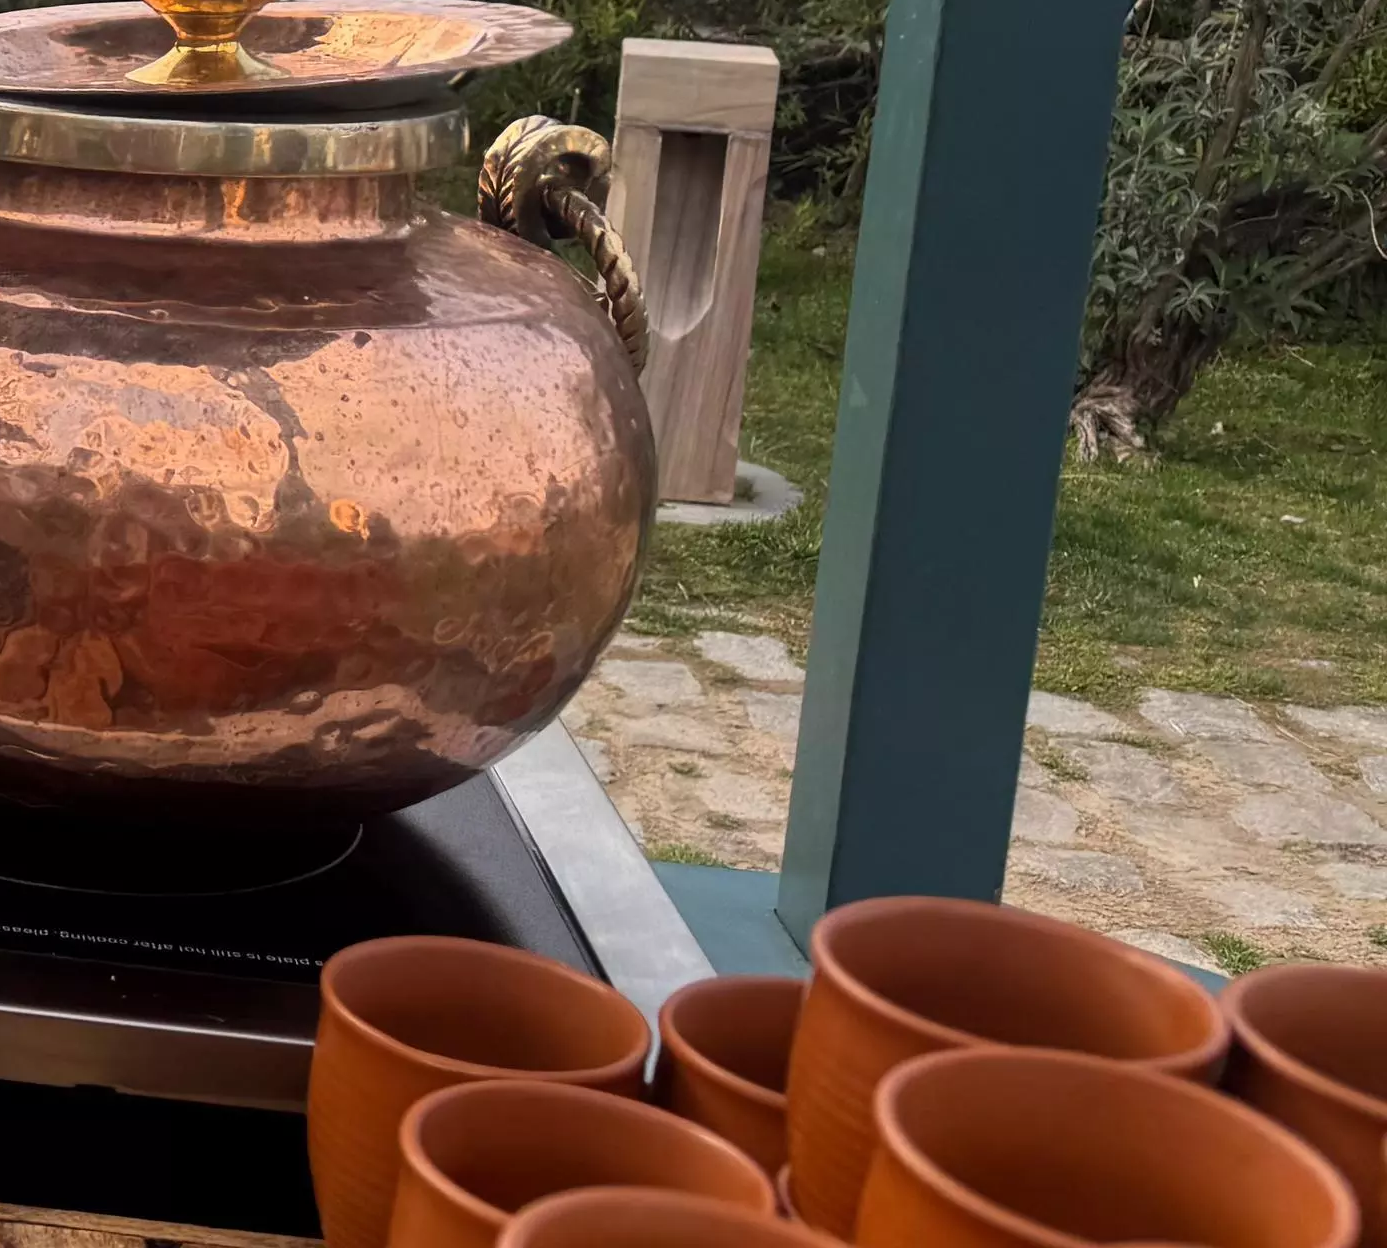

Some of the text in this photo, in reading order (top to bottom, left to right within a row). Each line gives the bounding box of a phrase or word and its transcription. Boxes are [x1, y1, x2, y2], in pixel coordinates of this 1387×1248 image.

[133, 940, 173, 951] after
[179, 945, 206, 955] hot
[211, 949, 242, 958] still
[265, 955, 310, 965] plate
